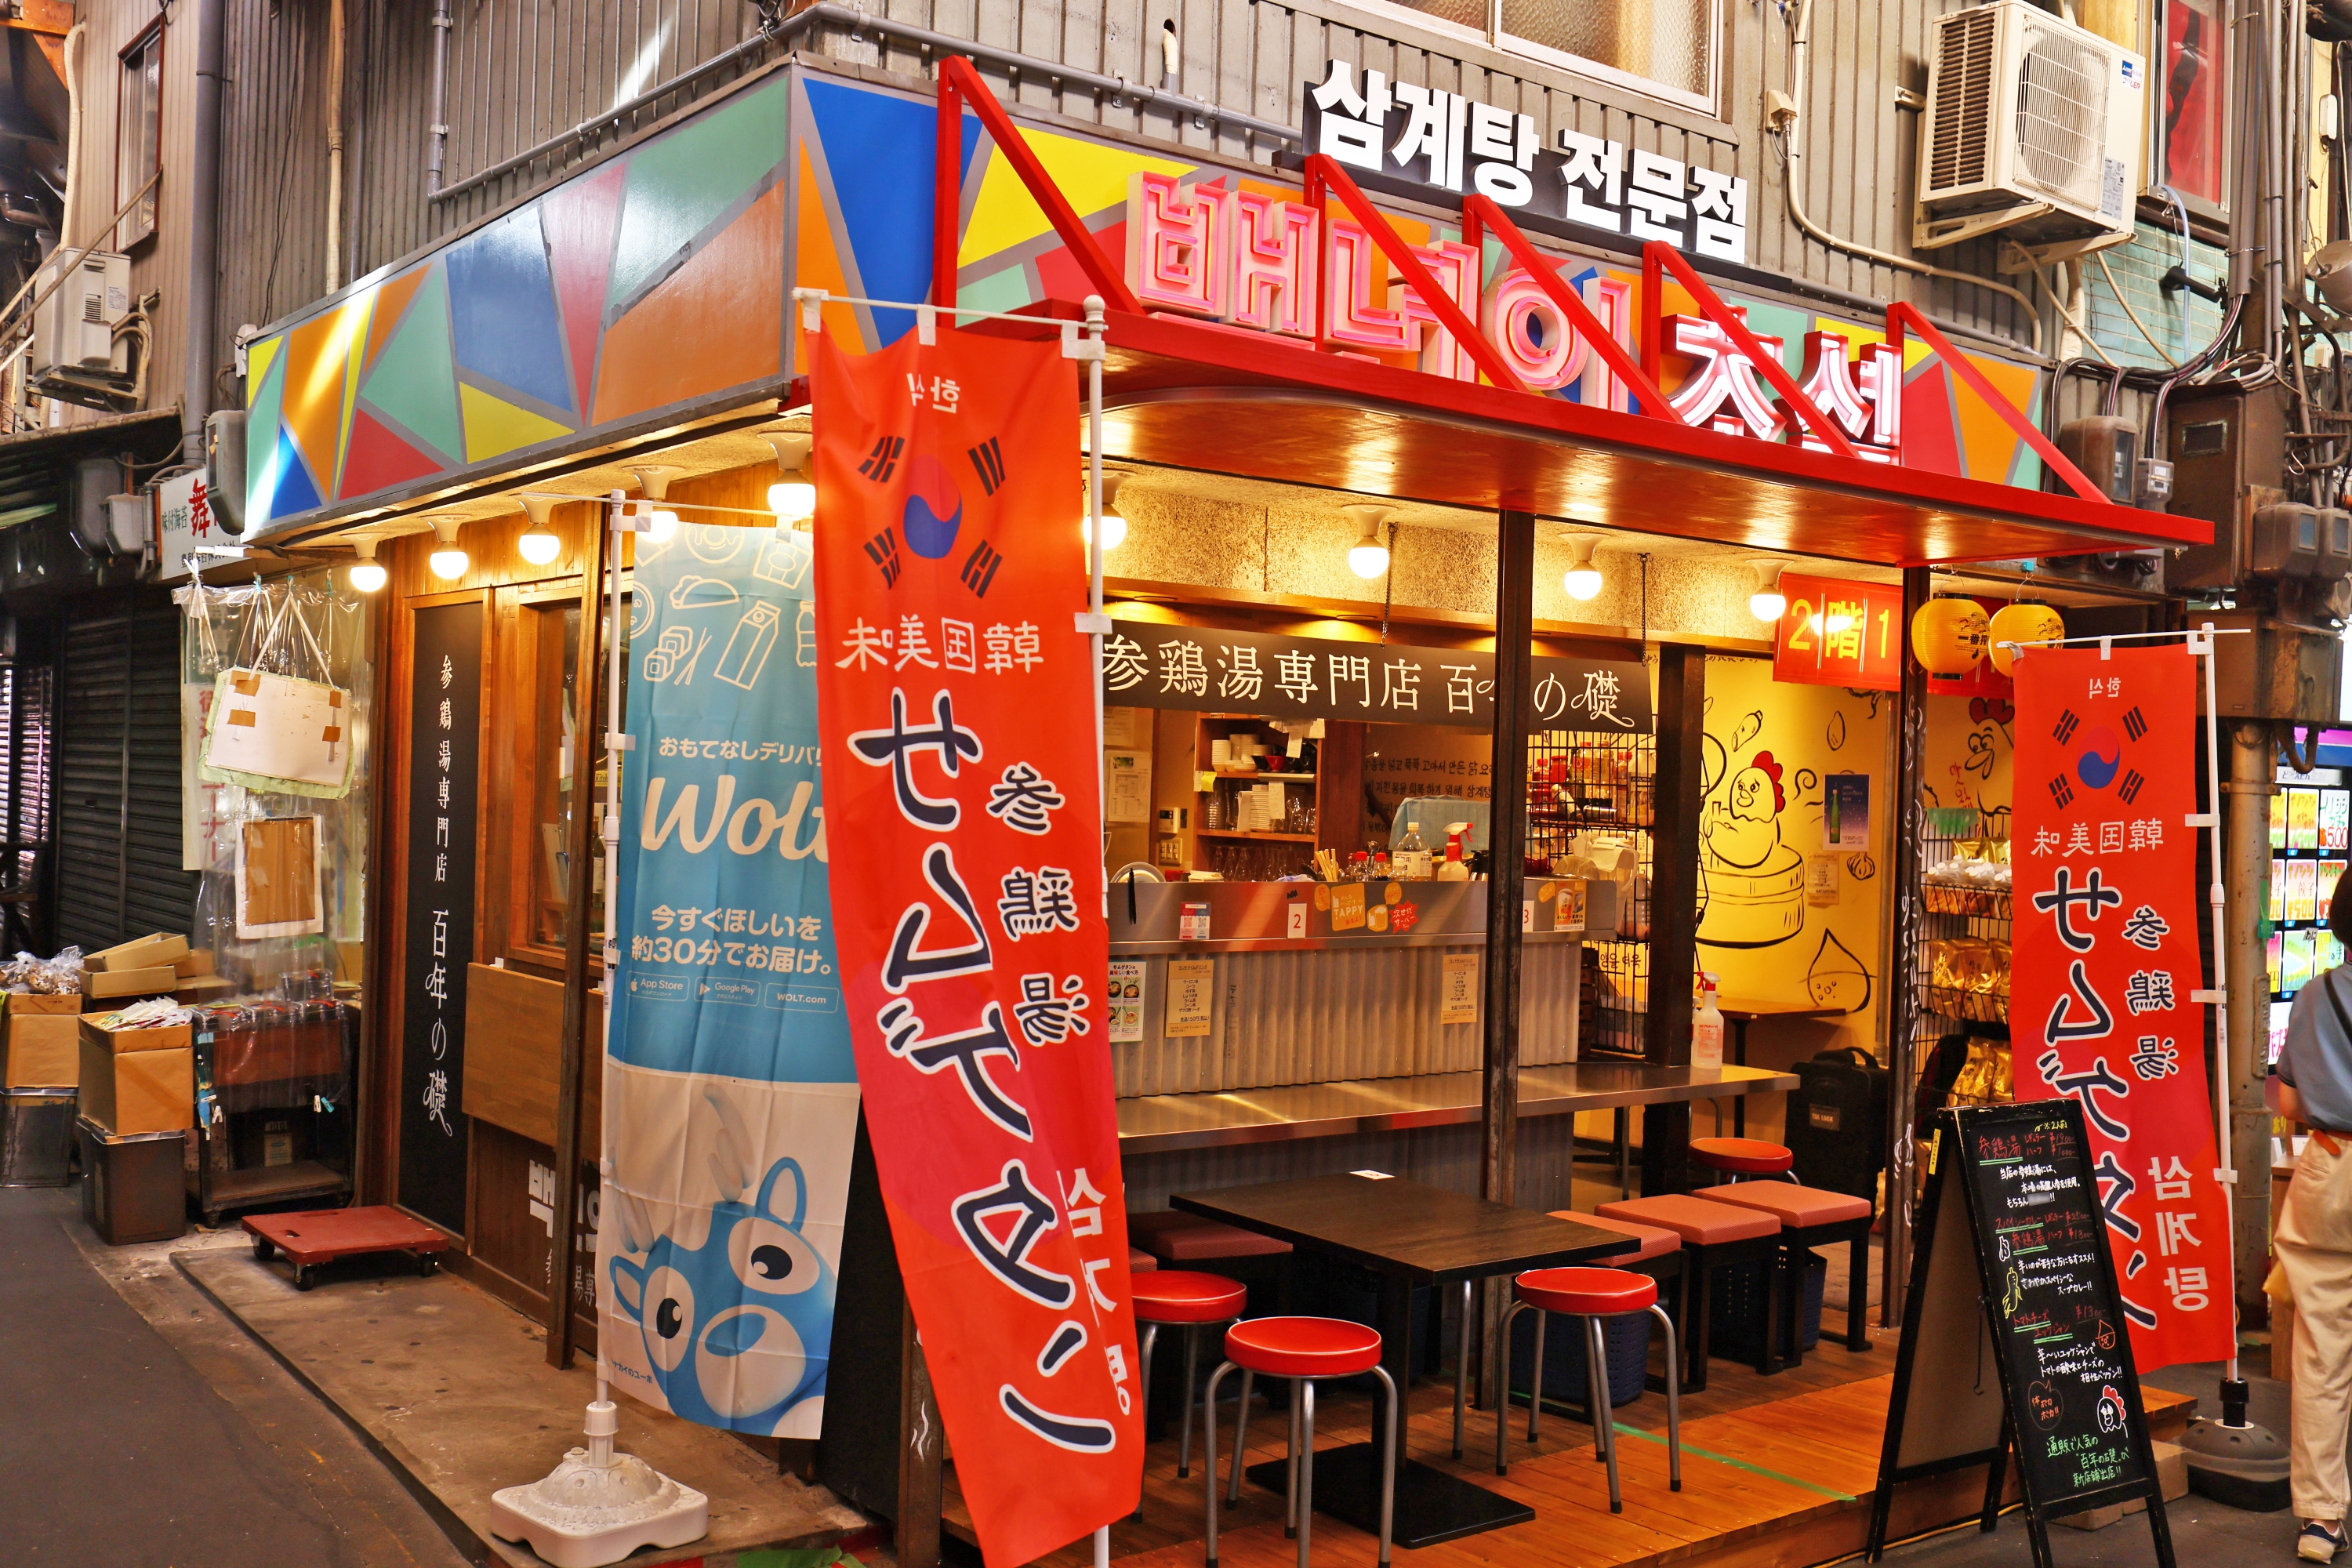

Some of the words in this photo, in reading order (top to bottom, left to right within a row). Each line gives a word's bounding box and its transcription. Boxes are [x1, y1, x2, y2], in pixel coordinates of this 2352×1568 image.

[1312, 59, 1541, 209] 삼계탕
[1558, 126, 1748, 265] 전문점
[162, 505, 187, 534] 味付海苔
[188, 477, 216, 539] 舞
[1102, 632, 1421, 712] 参鶏湯専門店
[1439, 663, 1635, 728] 百の礎
[434, 655, 454, 884] 参鶏湯専門店
[652, 904, 822, 941] 今すぐほしいを
[1293, 913, 1301, 929] 2
[631, 935, 831, 975] 約30分でお届け。
[640, 978, 657, 989] App
[659, 980, 684, 991] Store
[714, 982, 740, 993] Google
[740, 984, 756, 996] Play
[777, 992, 827, 1004] WOLT.com
[423, 909, 453, 1137] 百年の礎
[1979, 1135, 2022, 1161] 参鶏湯
[2027, 1146, 2043, 1156] ハーフ
[1995, 1217, 2042, 1230] スパイシーカレー
[2012, 1229, 2045, 1252] 参鶏湯
[2048, 1230, 2063, 1241] ハーフ
[2013, 1308, 2051, 1327] トマトチーズ
[2040, 1356, 2105, 1377] トマトの酸味とチーズの
[2046, 1433, 2099, 1458] 通販で人気の
